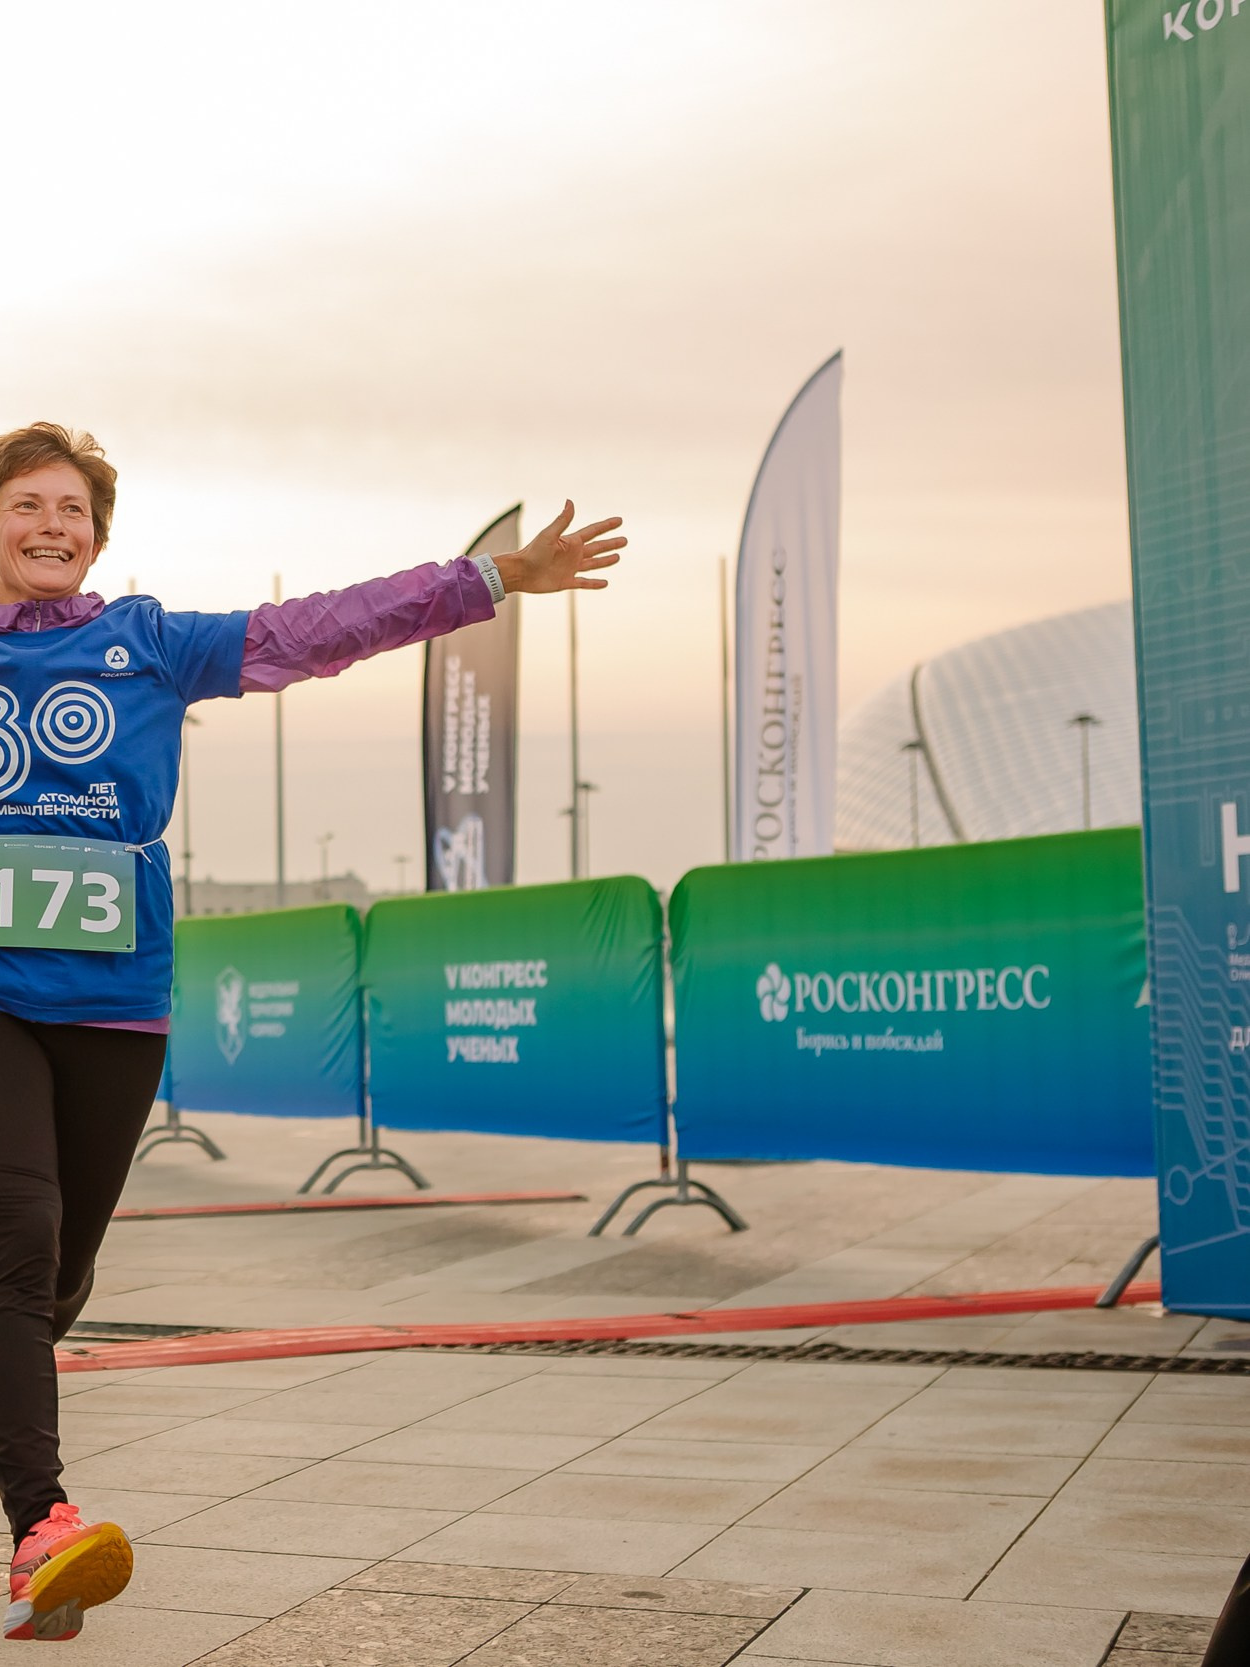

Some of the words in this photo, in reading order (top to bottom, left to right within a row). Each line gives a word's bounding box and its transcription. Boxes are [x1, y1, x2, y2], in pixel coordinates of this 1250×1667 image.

[37, 792, 119, 807] АТОМНОЙ
[87, 782, 117, 795] ЛЕТ
[445, 964, 458, 990] V
[460, 960, 548, 989] КОНГРЕСС
[794, 964, 1051, 1013] РОСКОНГРЕСС
[445, 998, 537, 1031] МОЛОДЫХ
[446, 1035, 520, 1064] УЧЕНЫХ
[796, 1026, 849, 1057] Борись
[852, 1035, 862, 1050] и
[865, 1026, 944, 1051] побеждай
